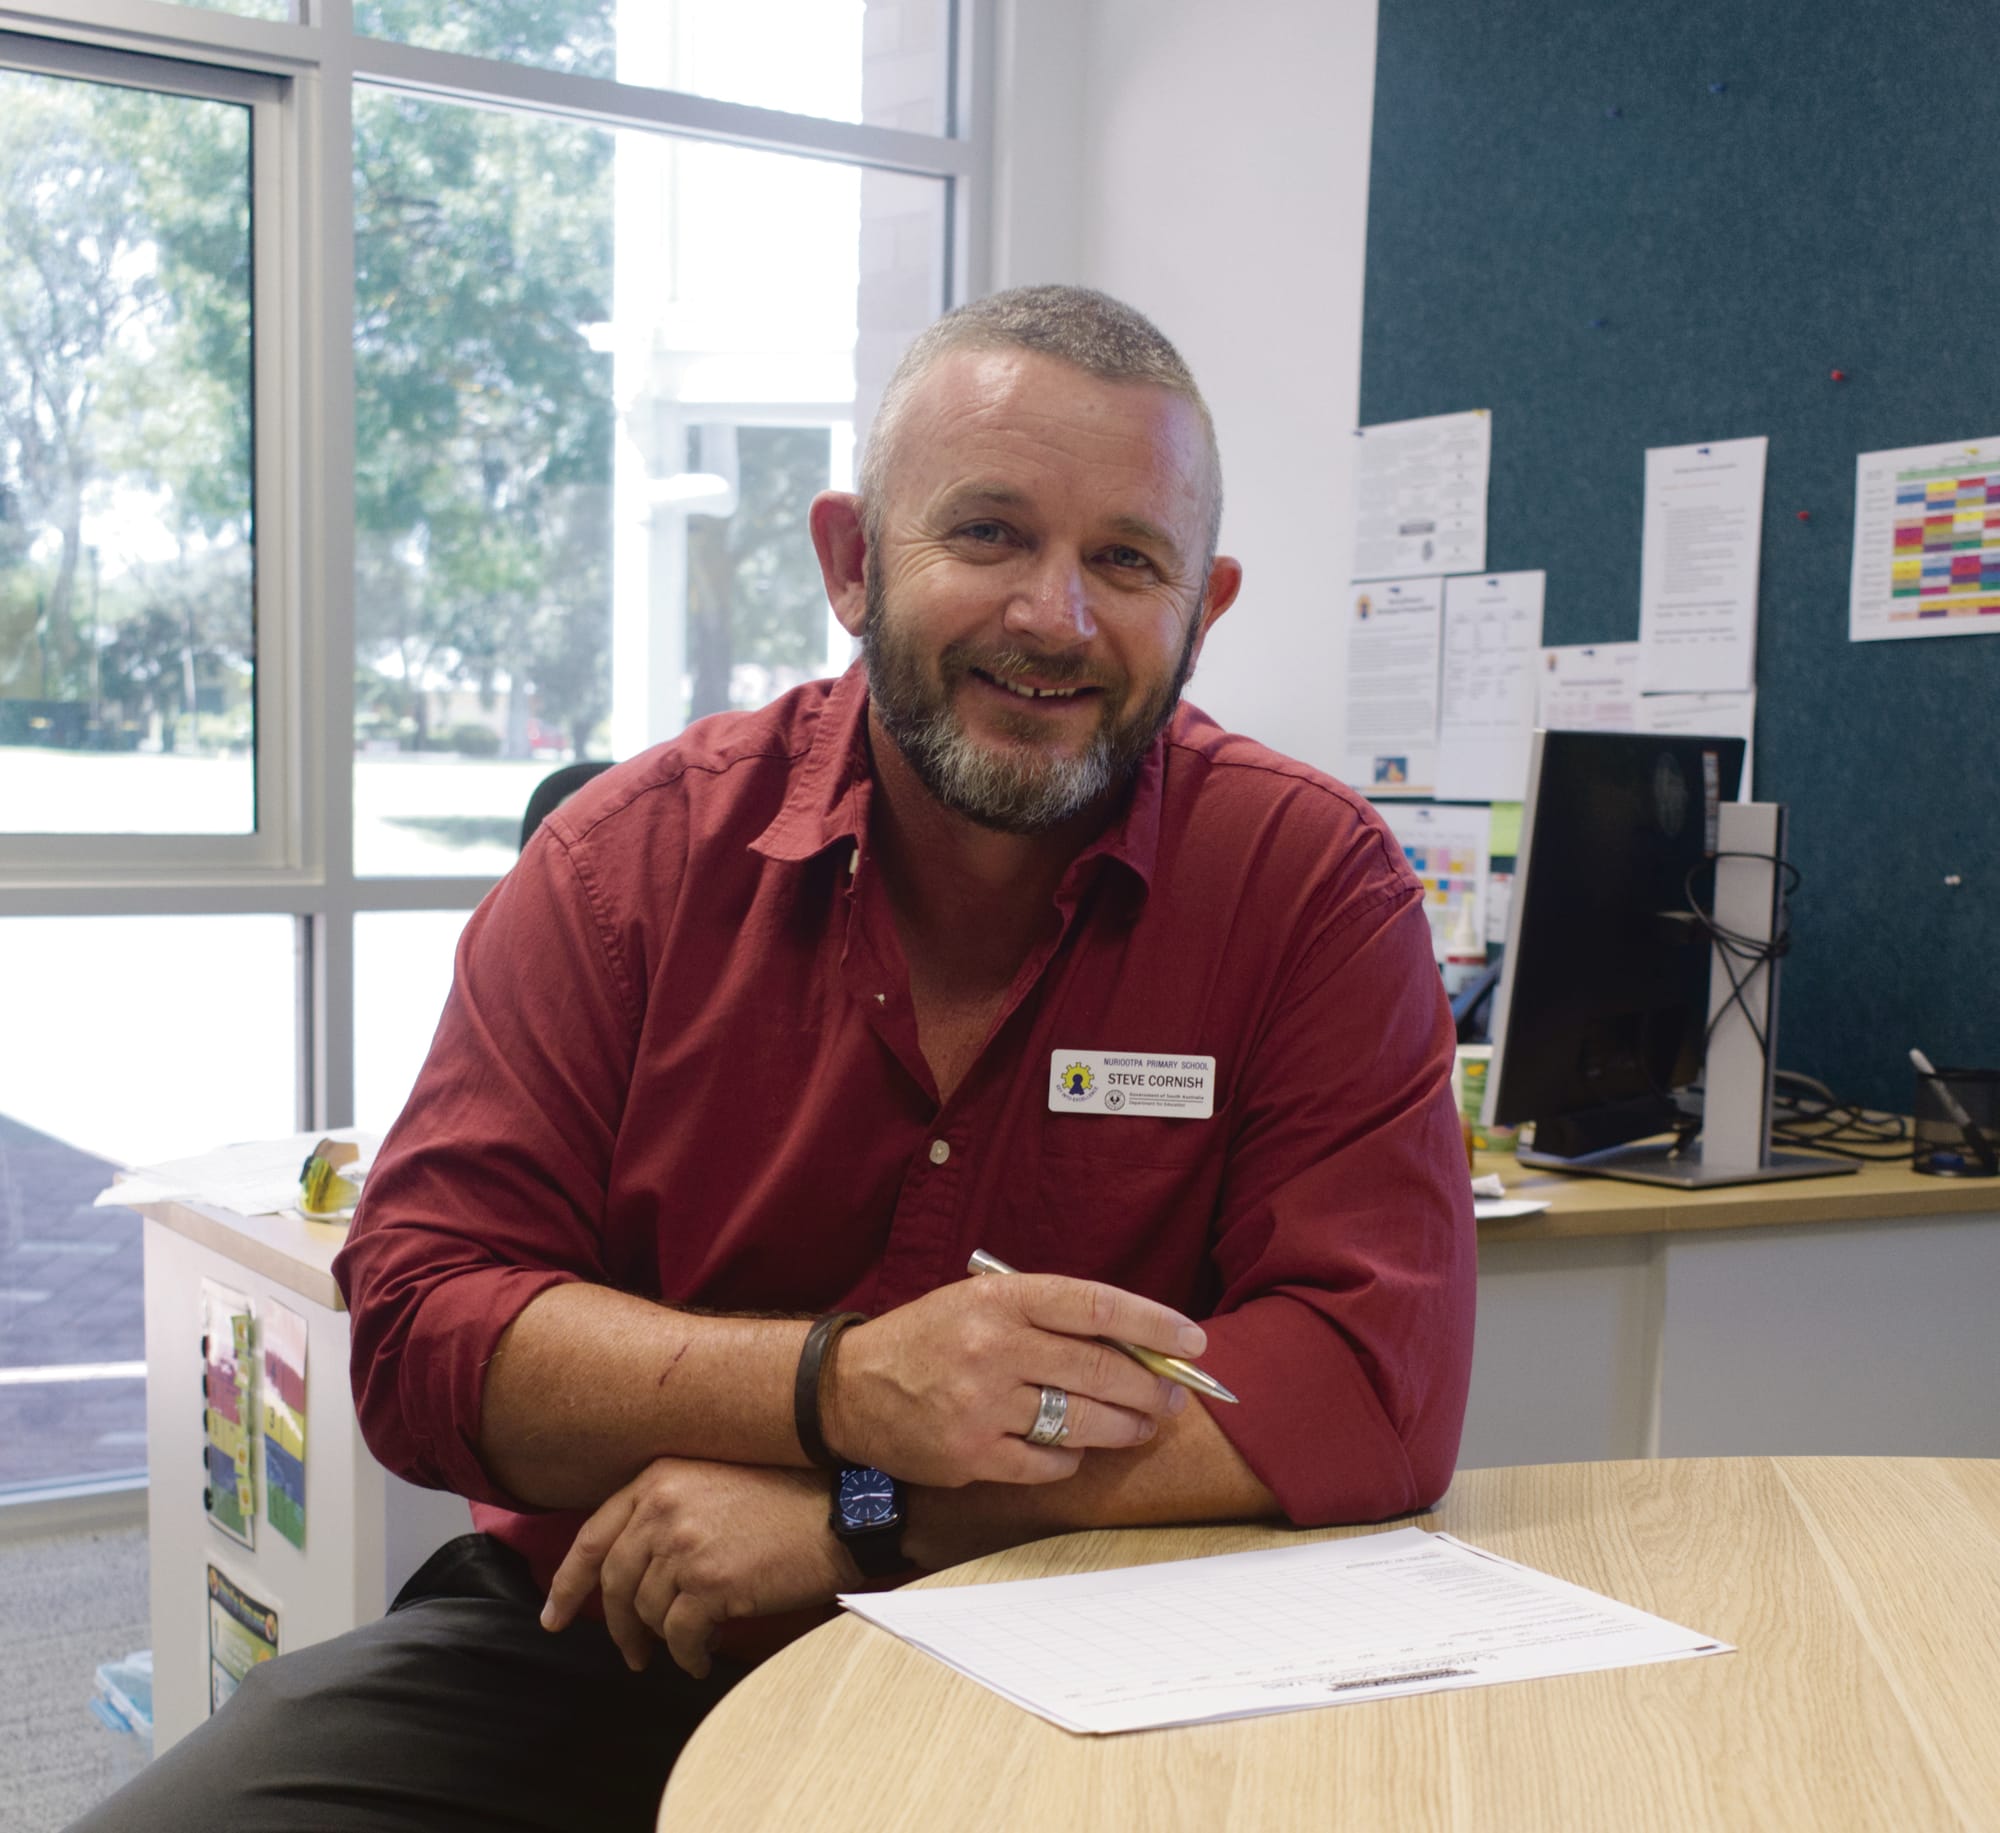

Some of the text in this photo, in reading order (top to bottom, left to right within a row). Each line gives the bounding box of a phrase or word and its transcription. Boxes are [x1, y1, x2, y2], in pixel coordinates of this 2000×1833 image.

[1104, 1058, 1209, 1070] NURIOOTPA PRIMARY SCHOOL
[1108, 1073, 1204, 1088] STEVE CORNISH
